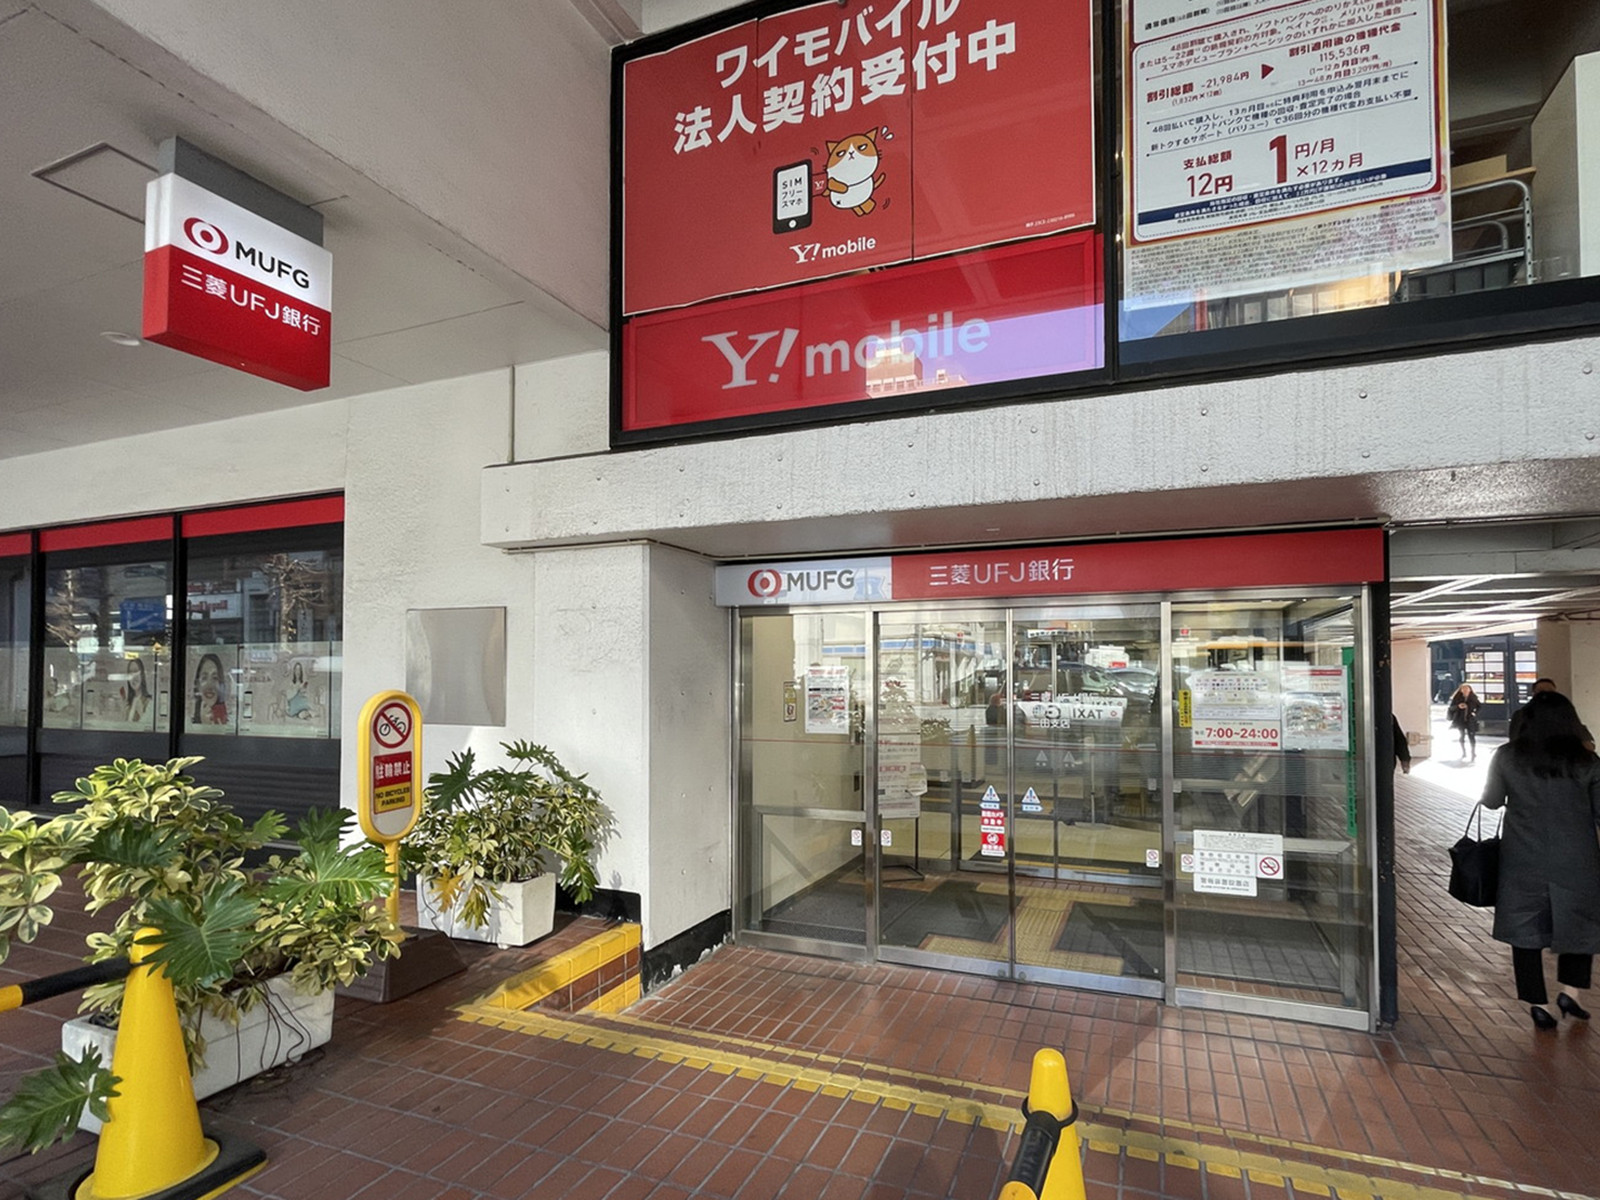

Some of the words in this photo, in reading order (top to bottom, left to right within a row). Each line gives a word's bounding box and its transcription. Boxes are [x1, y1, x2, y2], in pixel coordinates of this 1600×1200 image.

[716, 0, 961, 88] ワイモバイル
[1289, 21, 1401, 57] 割引適用後の機種代金
[1319, 41, 1370, 63] 115,536円
[673, 19, 1016, 155] 法人契約受付中
[1146, 81, 1193, 103] 割引総額
[1183, 149, 1231, 170] 支払総額
[1269, 134, 1287, 185] 1
[1294, 137, 1334, 159] 円/月
[781, 189, 803, 199] フリー
[782, 177, 802, 190] SIM
[1187, 167, 1233, 199] 12円
[781, 198, 804, 208] スマホ
[235, 241, 310, 289] MUFG
[181, 264, 321, 336] 三菱UFJ銀行
[786, 570, 855, 592] MUFG
[929, 558, 1075, 586] 三菱UFJ銀行
[375, 761, 410, 779] 駐輪禁止
